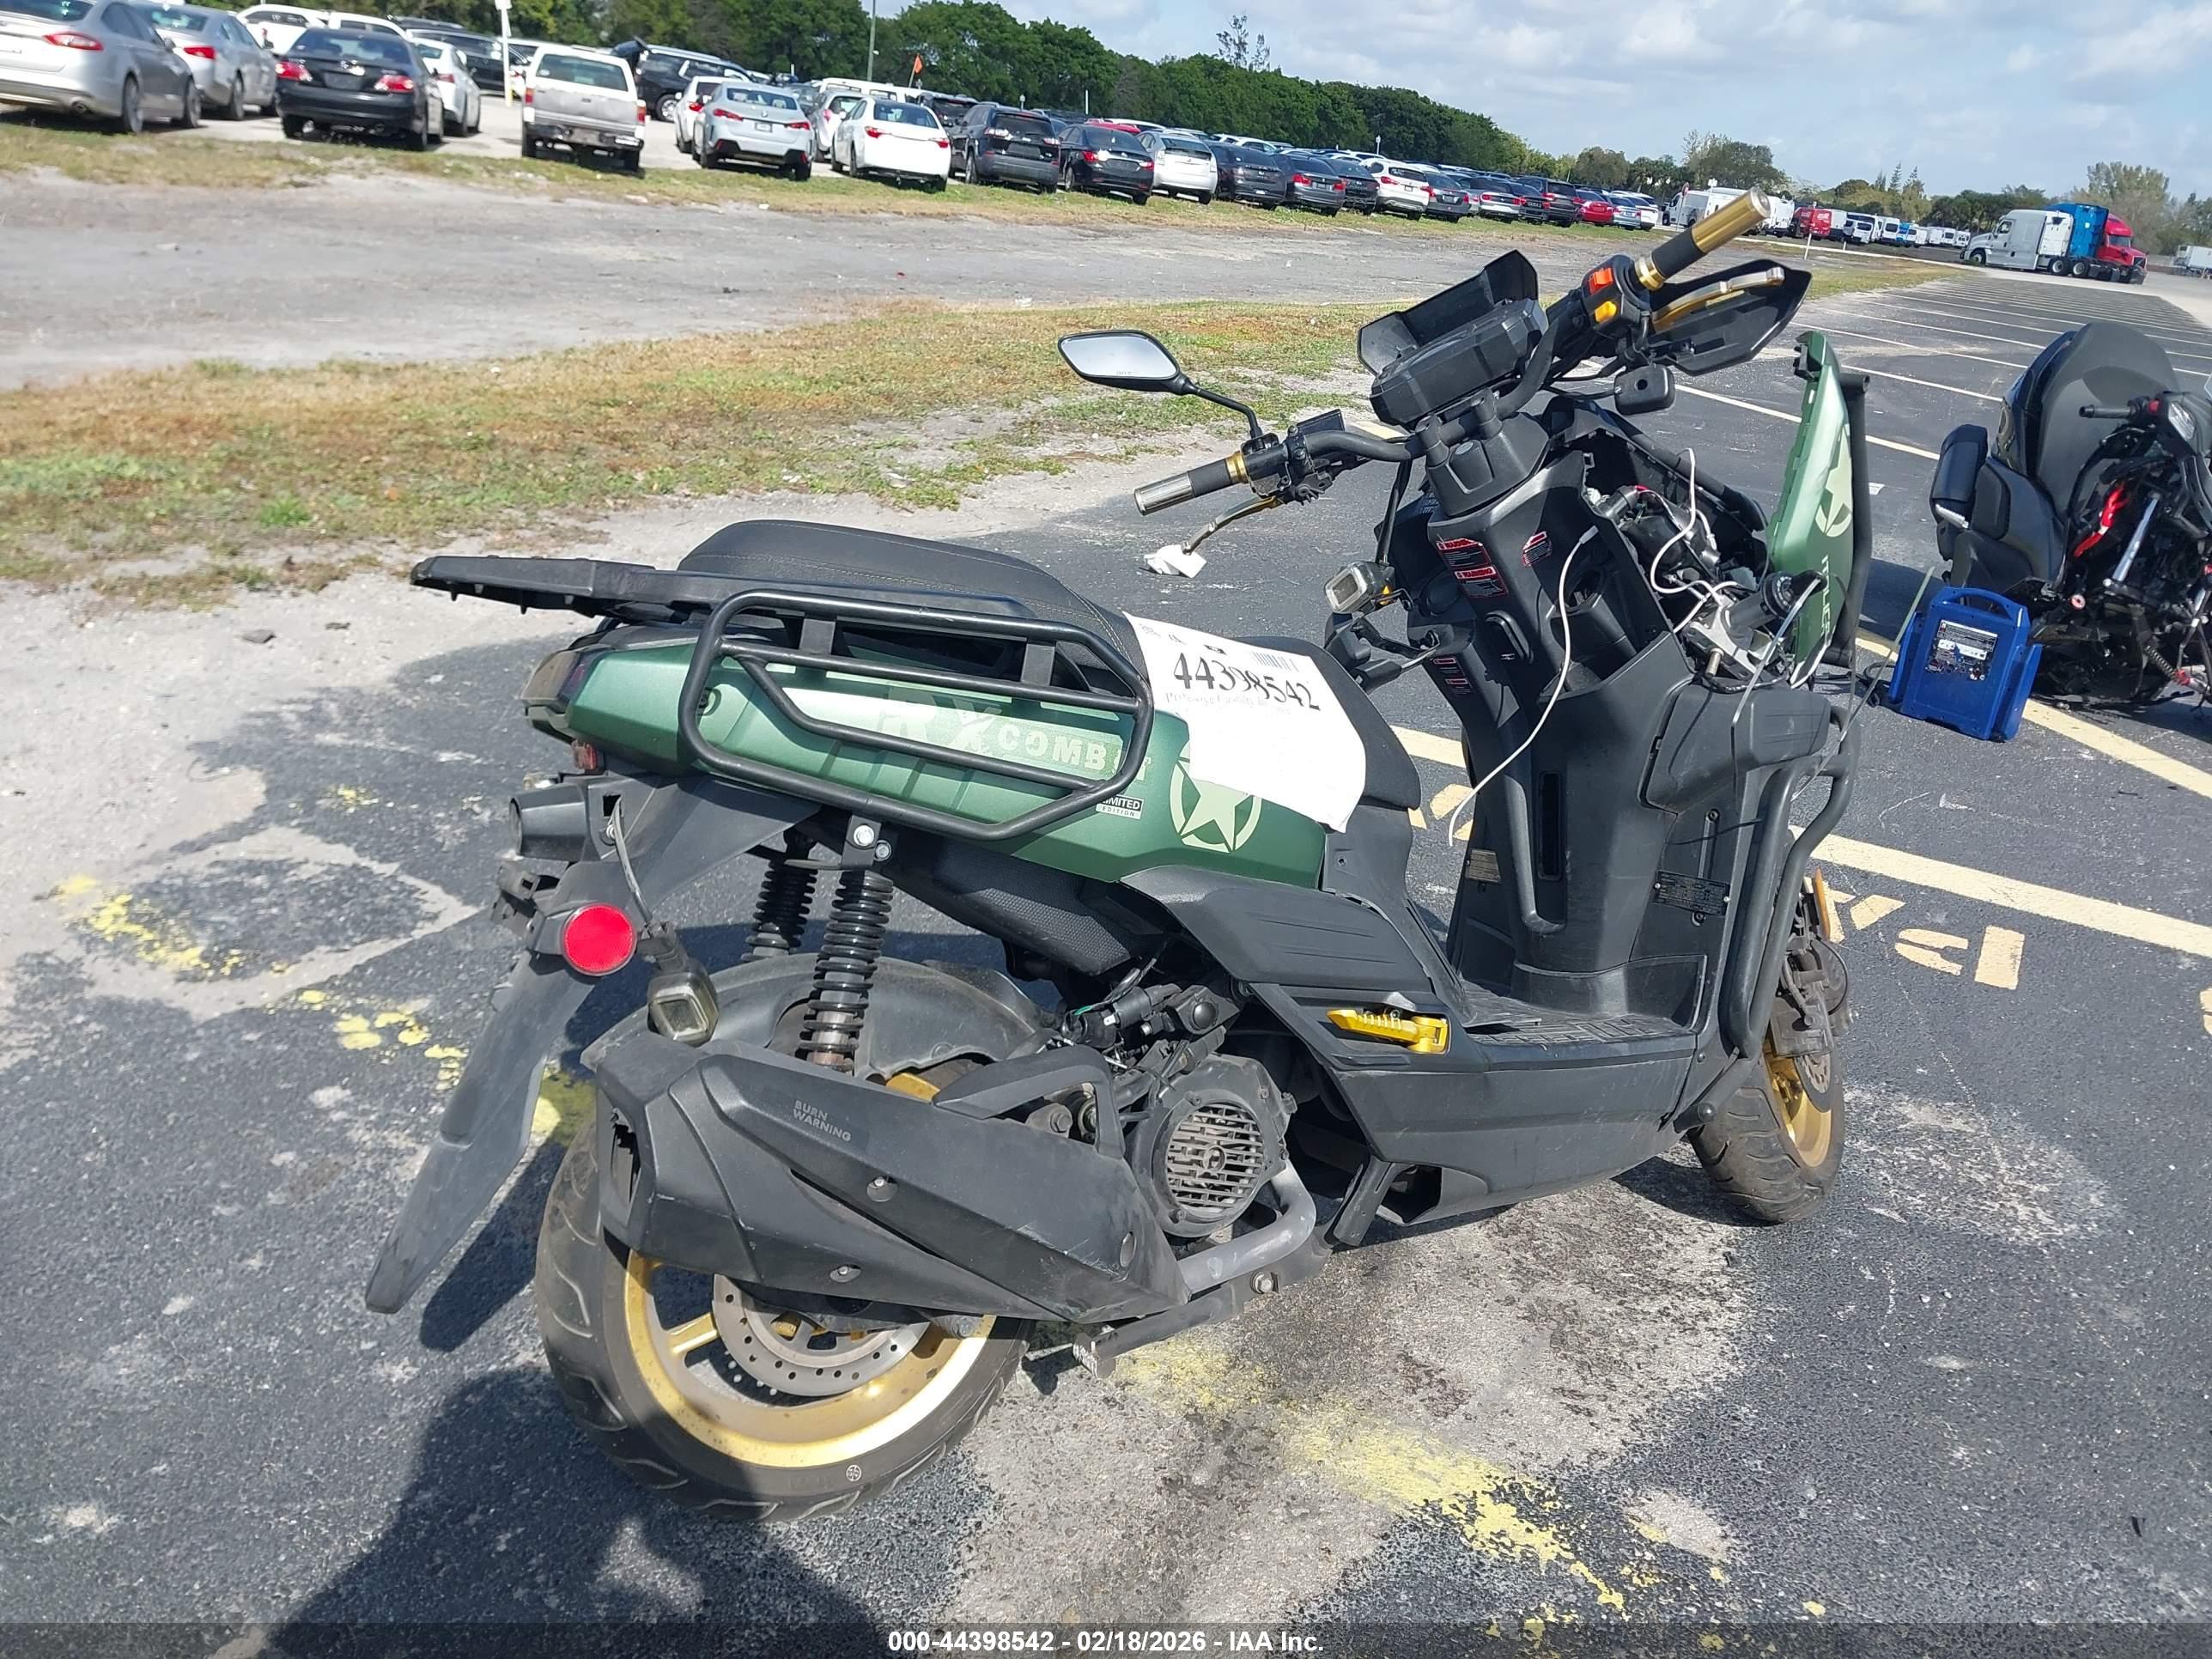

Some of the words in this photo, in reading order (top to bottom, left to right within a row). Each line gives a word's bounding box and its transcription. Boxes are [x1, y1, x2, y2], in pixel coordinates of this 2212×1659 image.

[1173, 652, 1322, 711] 44398542
[997, 724, 1152, 781] COMB
[1102, 805, 1135, 817] EDITION
[793, 1109, 852, 1141] WARNING
[794, 1100, 828, 1121] BURN
